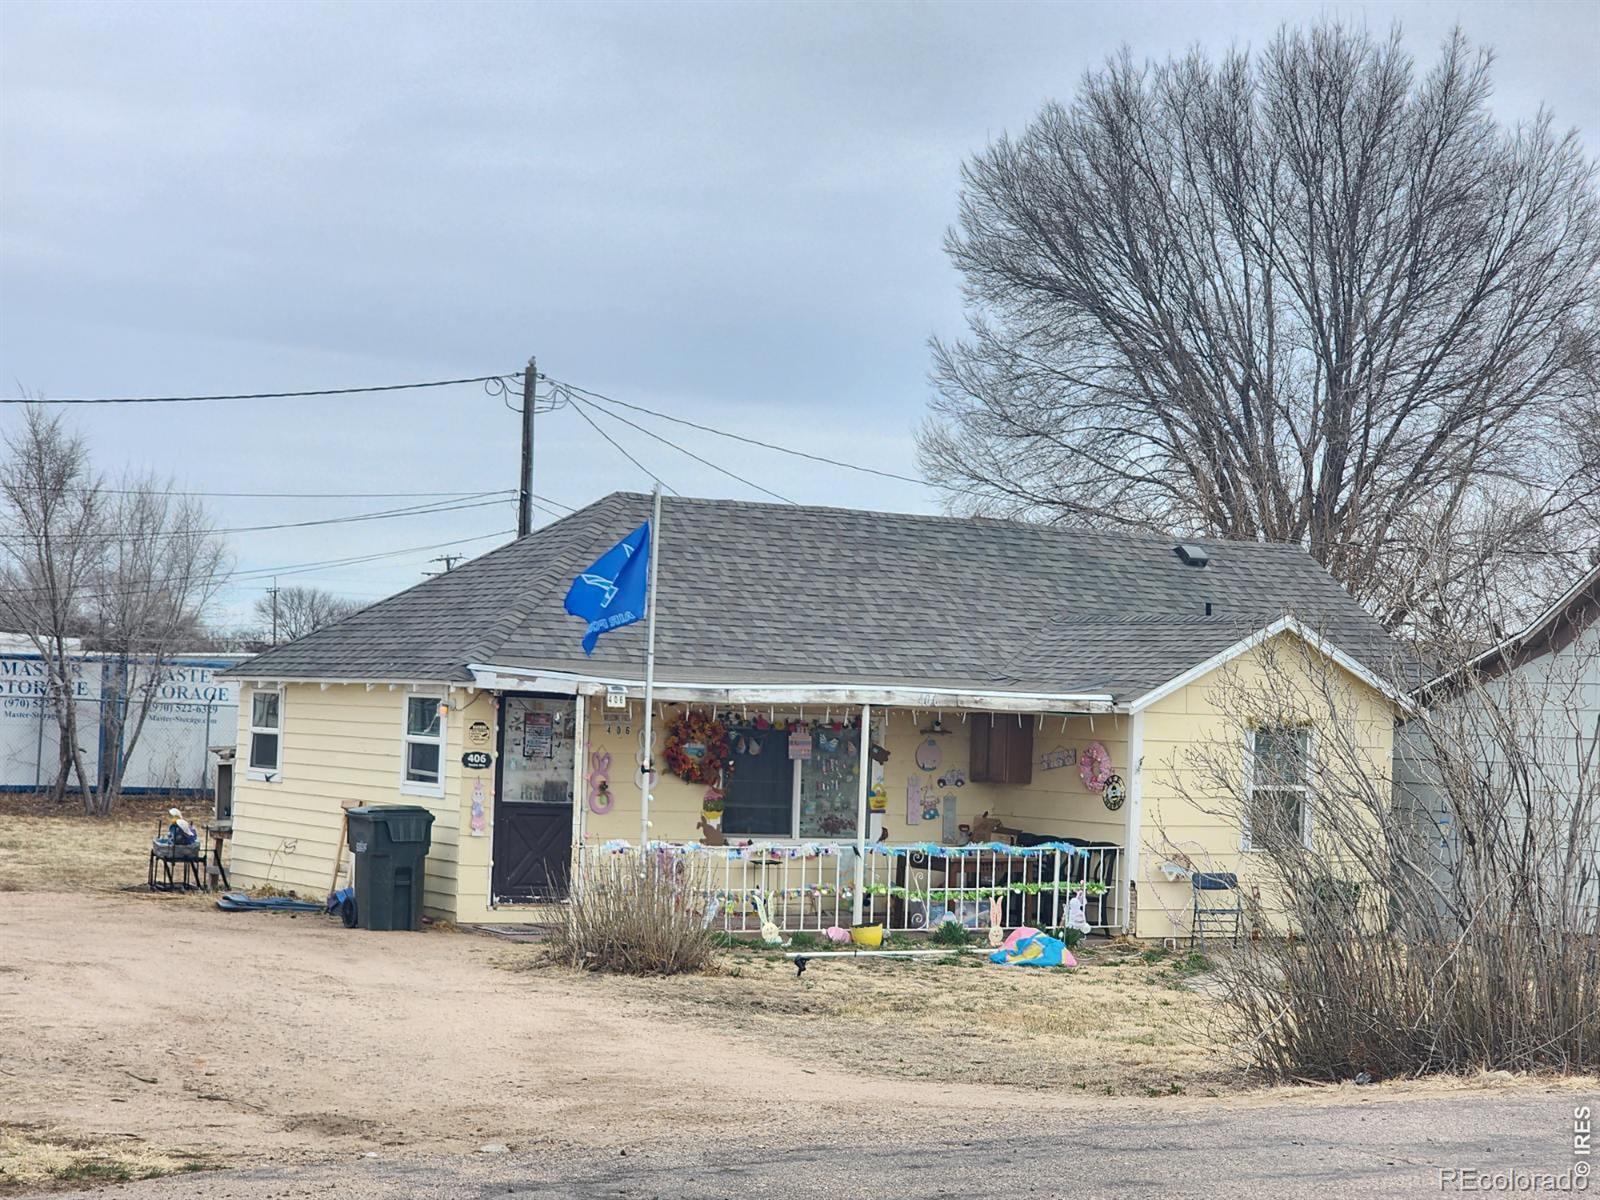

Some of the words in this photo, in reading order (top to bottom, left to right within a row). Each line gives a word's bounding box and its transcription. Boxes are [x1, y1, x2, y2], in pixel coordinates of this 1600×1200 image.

[1, 661, 83, 678] MASR
[158, 668, 211, 683] ASTE
[148, 714, 217, 724] Master-Storage.cm
[467, 754, 487, 764] 406
